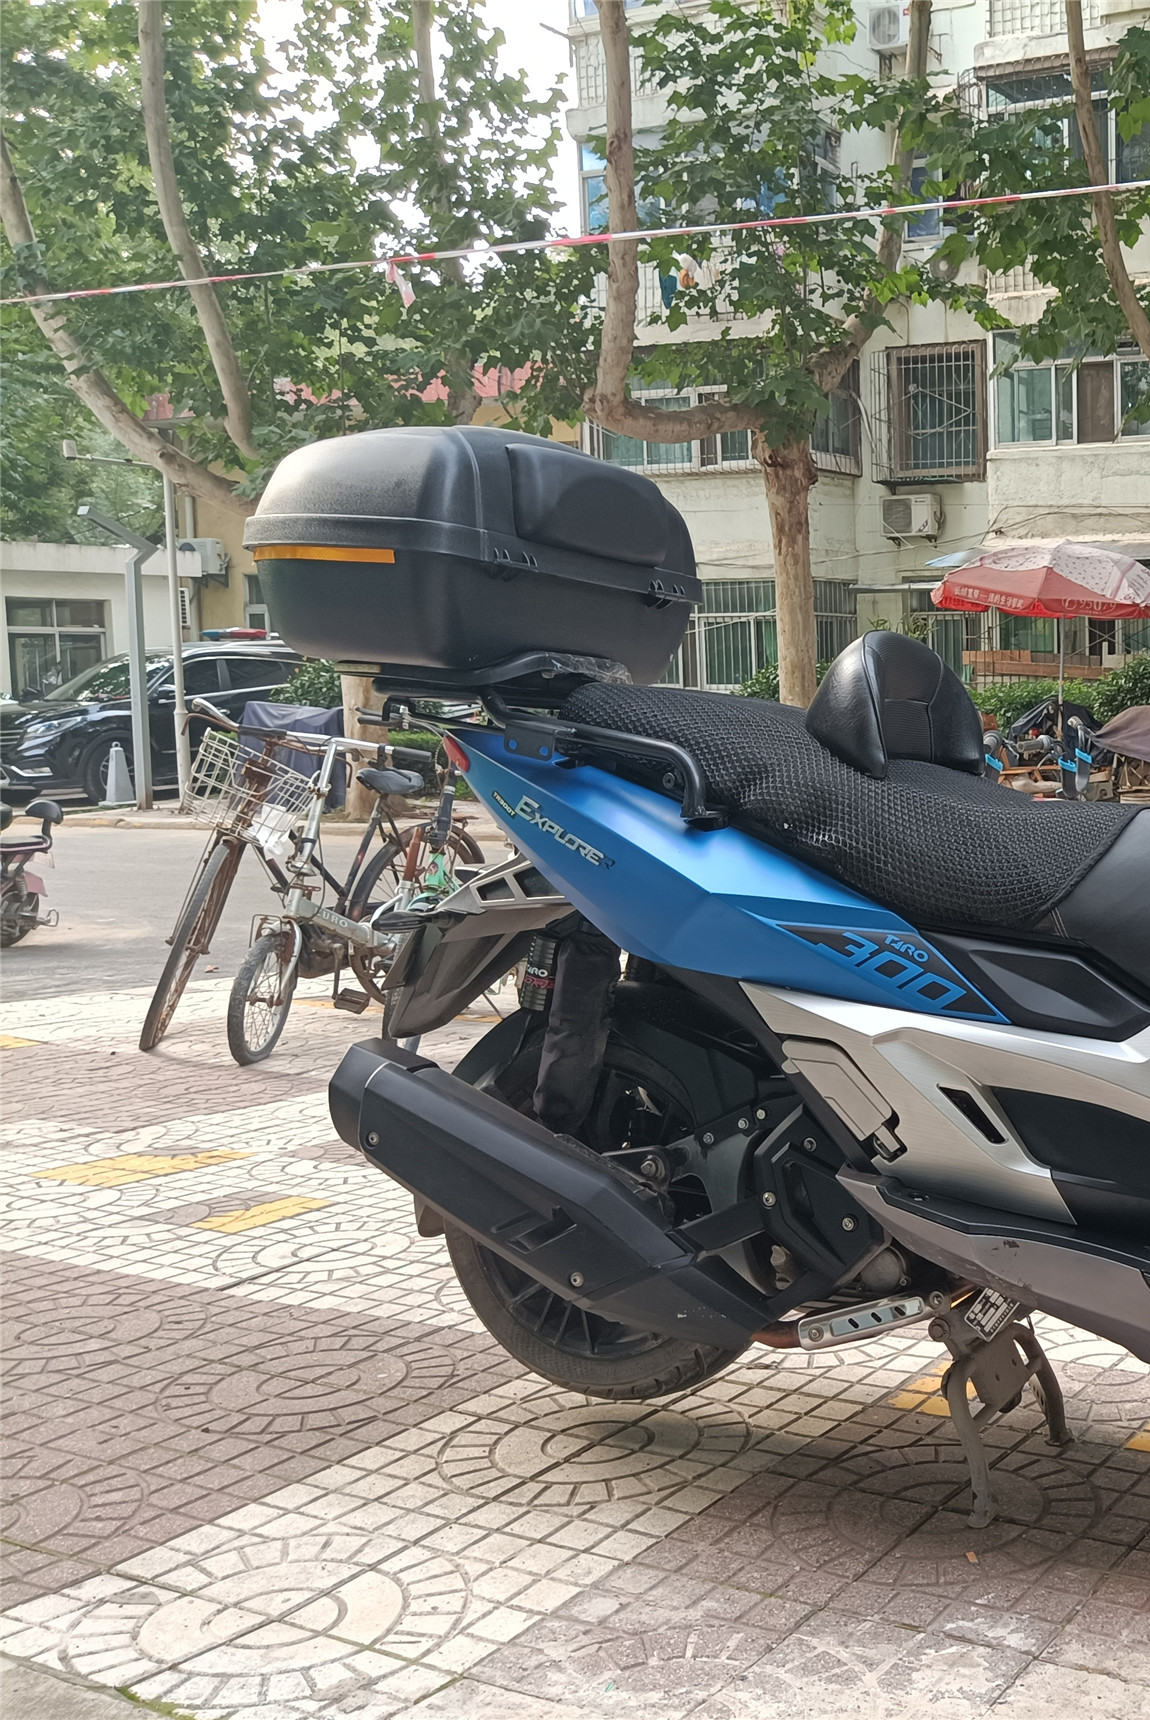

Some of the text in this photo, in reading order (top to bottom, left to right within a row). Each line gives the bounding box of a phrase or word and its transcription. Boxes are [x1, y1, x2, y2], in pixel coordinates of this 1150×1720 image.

[1079, 599, 1117, 613] 95079
[885, 934, 930, 963] TARO
[815, 931, 968, 1010] 300
